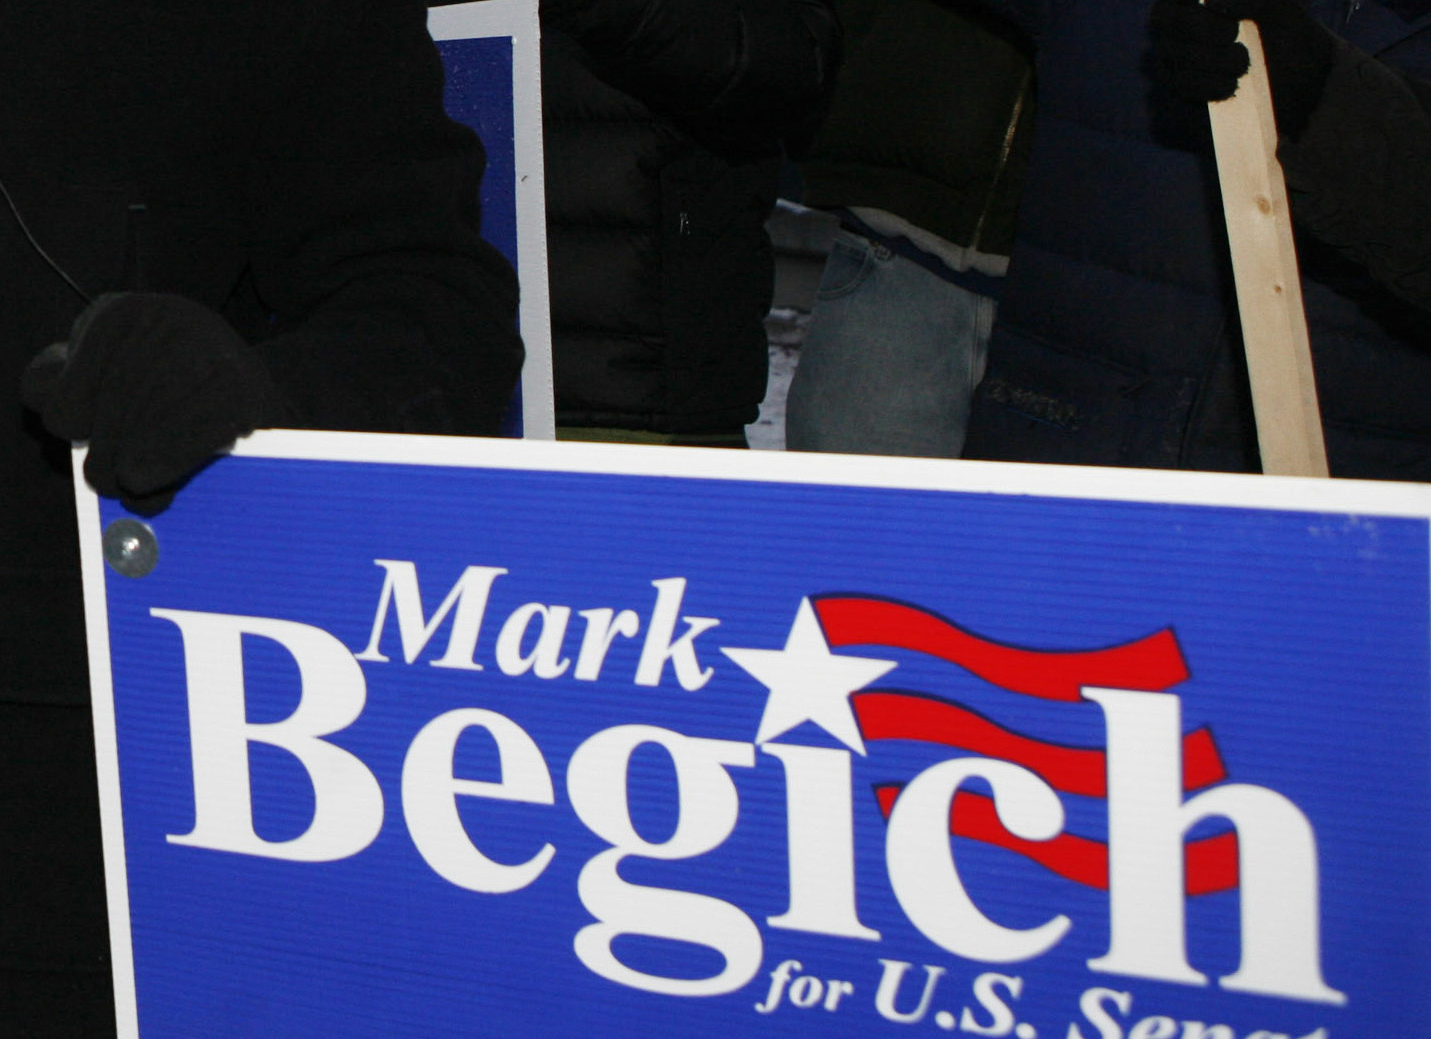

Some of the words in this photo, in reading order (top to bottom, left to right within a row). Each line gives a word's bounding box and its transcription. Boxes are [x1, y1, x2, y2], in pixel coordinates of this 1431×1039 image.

[364, 559, 721, 693] Mark
[149, 607, 1348, 1005] Begich
[754, 959, 854, 1014] for
[874, 958, 1037, 1039] U.S.
